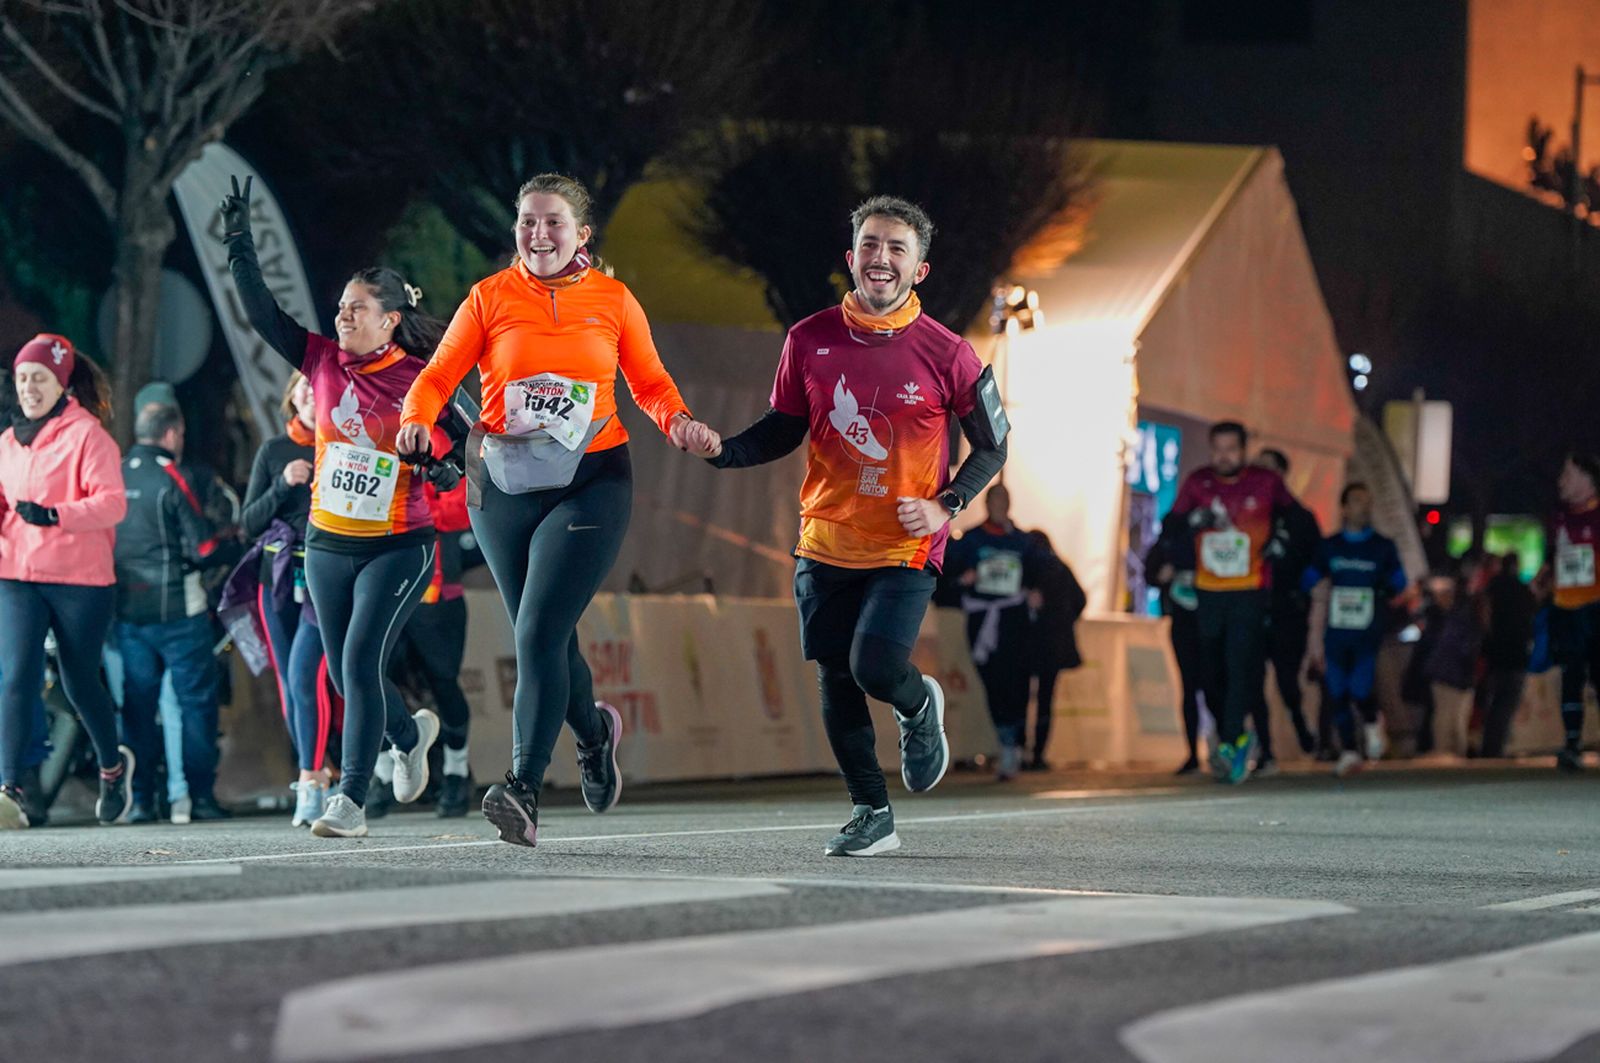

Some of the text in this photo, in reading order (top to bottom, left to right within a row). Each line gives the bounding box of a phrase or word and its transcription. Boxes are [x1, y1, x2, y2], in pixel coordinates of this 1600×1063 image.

[342, 417, 362, 438] 43
[845, 421, 870, 446] 43
[331, 468, 382, 498] 6362
